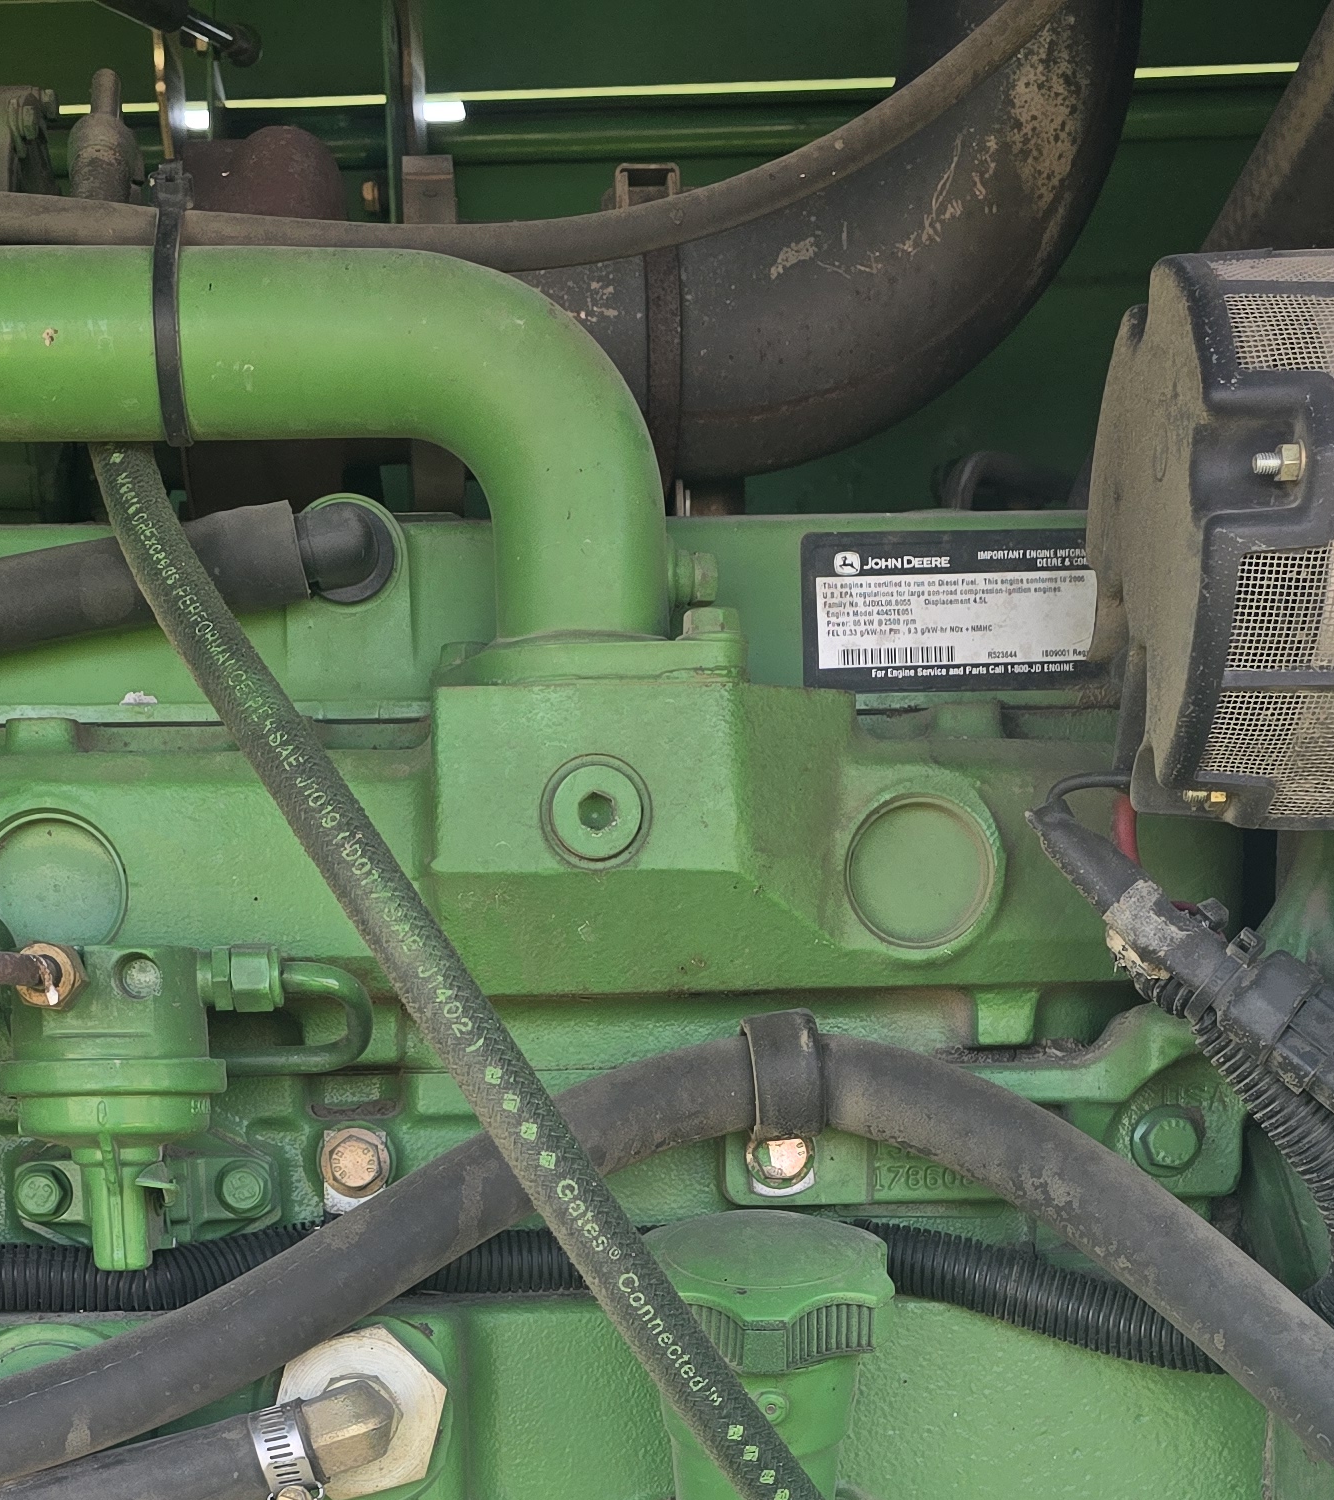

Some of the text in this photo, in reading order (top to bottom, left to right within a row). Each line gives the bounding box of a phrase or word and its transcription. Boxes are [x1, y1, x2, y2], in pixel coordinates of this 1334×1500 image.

[863, 556, 901, 570] JOHN
[904, 555, 951, 569] DEERE
[977, 549, 1024, 560] IMPORTANT
[1026, 548, 1054, 559] ENGINE
[1037, 557, 1063, 567] DEERE
[823, 582, 838, 591] This
[840, 581, 863, 591] engine
[873, 580, 902, 589] certified
[938, 578, 959, 587] Diesel
[984, 577, 998, 586] This
[1000, 577, 1024, 587] engine
[840, 591, 854, 600] EPA
[855, 589, 894, 600] regulations
[896, 589, 906, 598] for
[907, 588, 925, 599] large
[823, 600, 847, 611] Family
[826, 609, 851, 619] Engine
[852, 609, 875, 618] Model
[871, 669, 886, 678] For
[887, 668, 915, 679] Engine
[916, 666, 947, 677] Service
[948, 666, 964, 676] and
[966, 665, 987, 675] Parts
[988, 664, 1005, 675] Call
[1043, 662, 1075, 673] ENGINE
